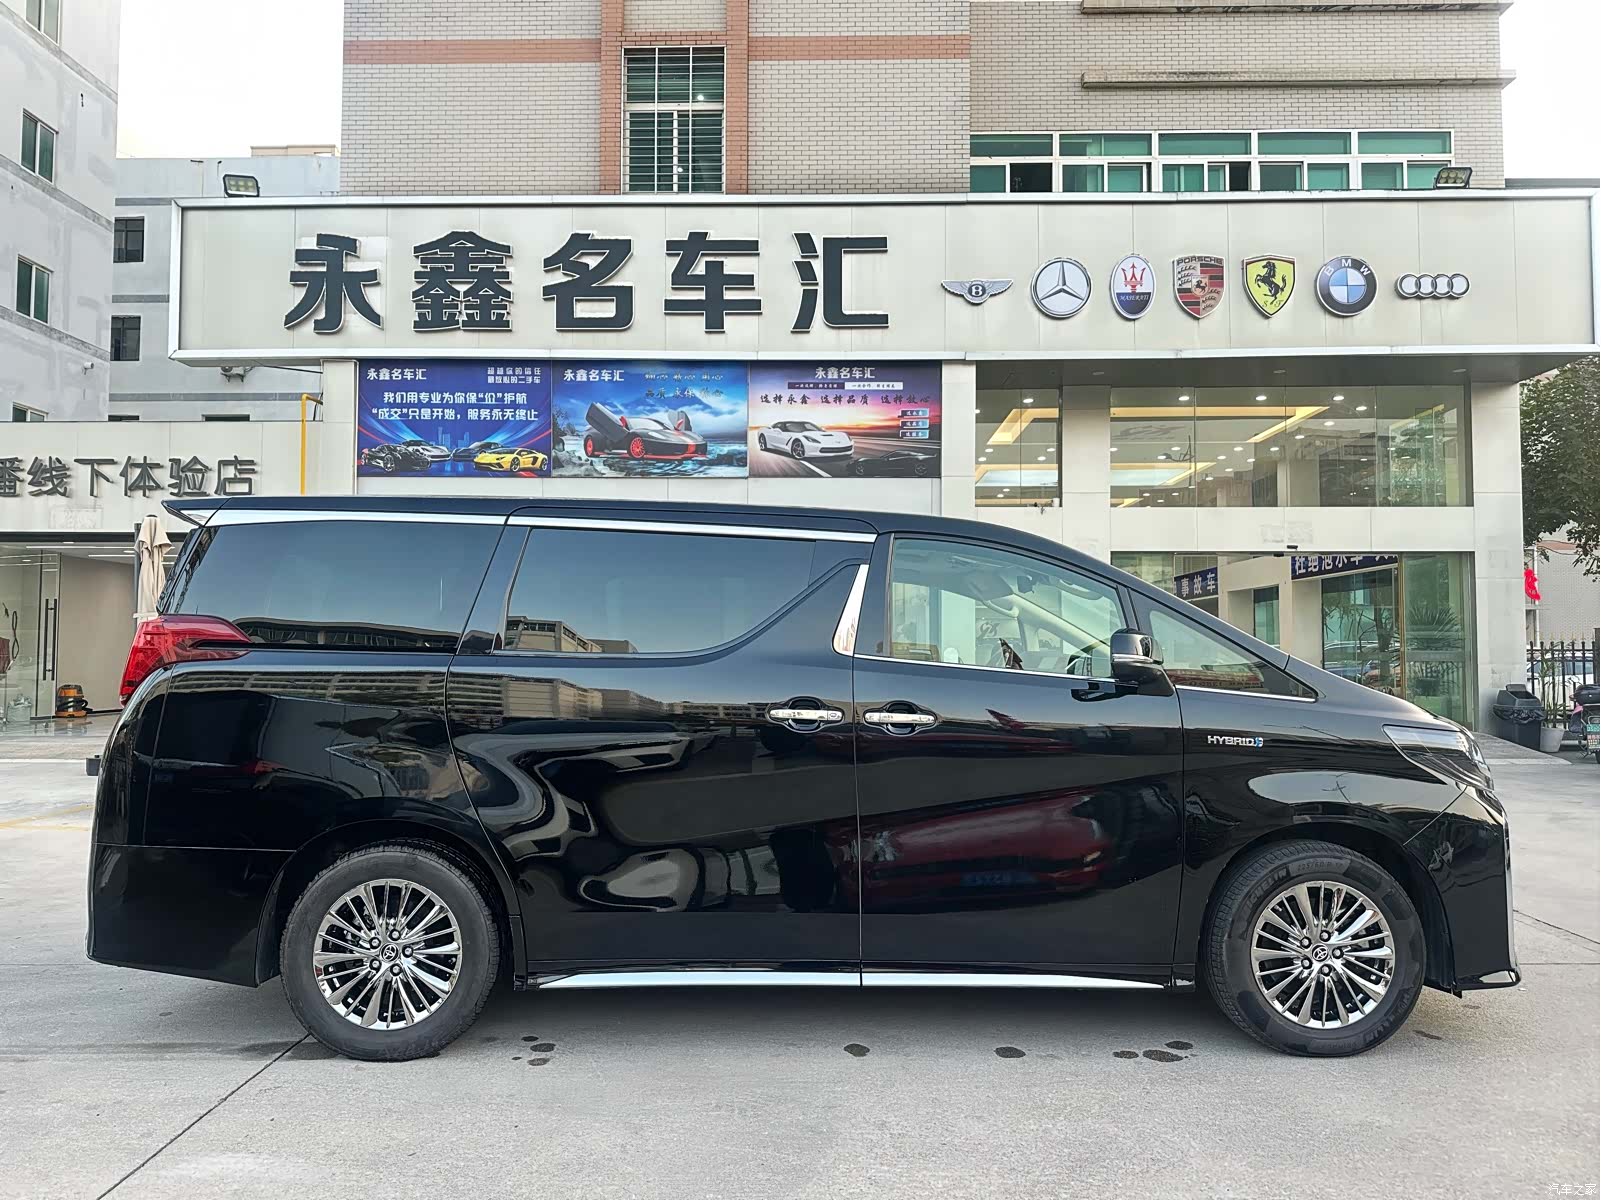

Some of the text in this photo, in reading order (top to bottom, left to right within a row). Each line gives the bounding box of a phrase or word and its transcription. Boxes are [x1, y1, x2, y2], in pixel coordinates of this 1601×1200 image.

[1176, 256, 1223, 266] PORSCHE
[1323, 258, 1370, 277] BMW
[283, 230, 890, 334] 永鑫名车汇
[971, 285, 983, 296] B
[366, 367, 427, 381] 永鑫名车汇
[562, 368, 625, 382] 永鑫名车汇
[814, 367, 876, 379] 永鑫名车汇
[1174, 572, 1216, 598] 事故车
[1207, 735, 1255, 747] HYBRID
